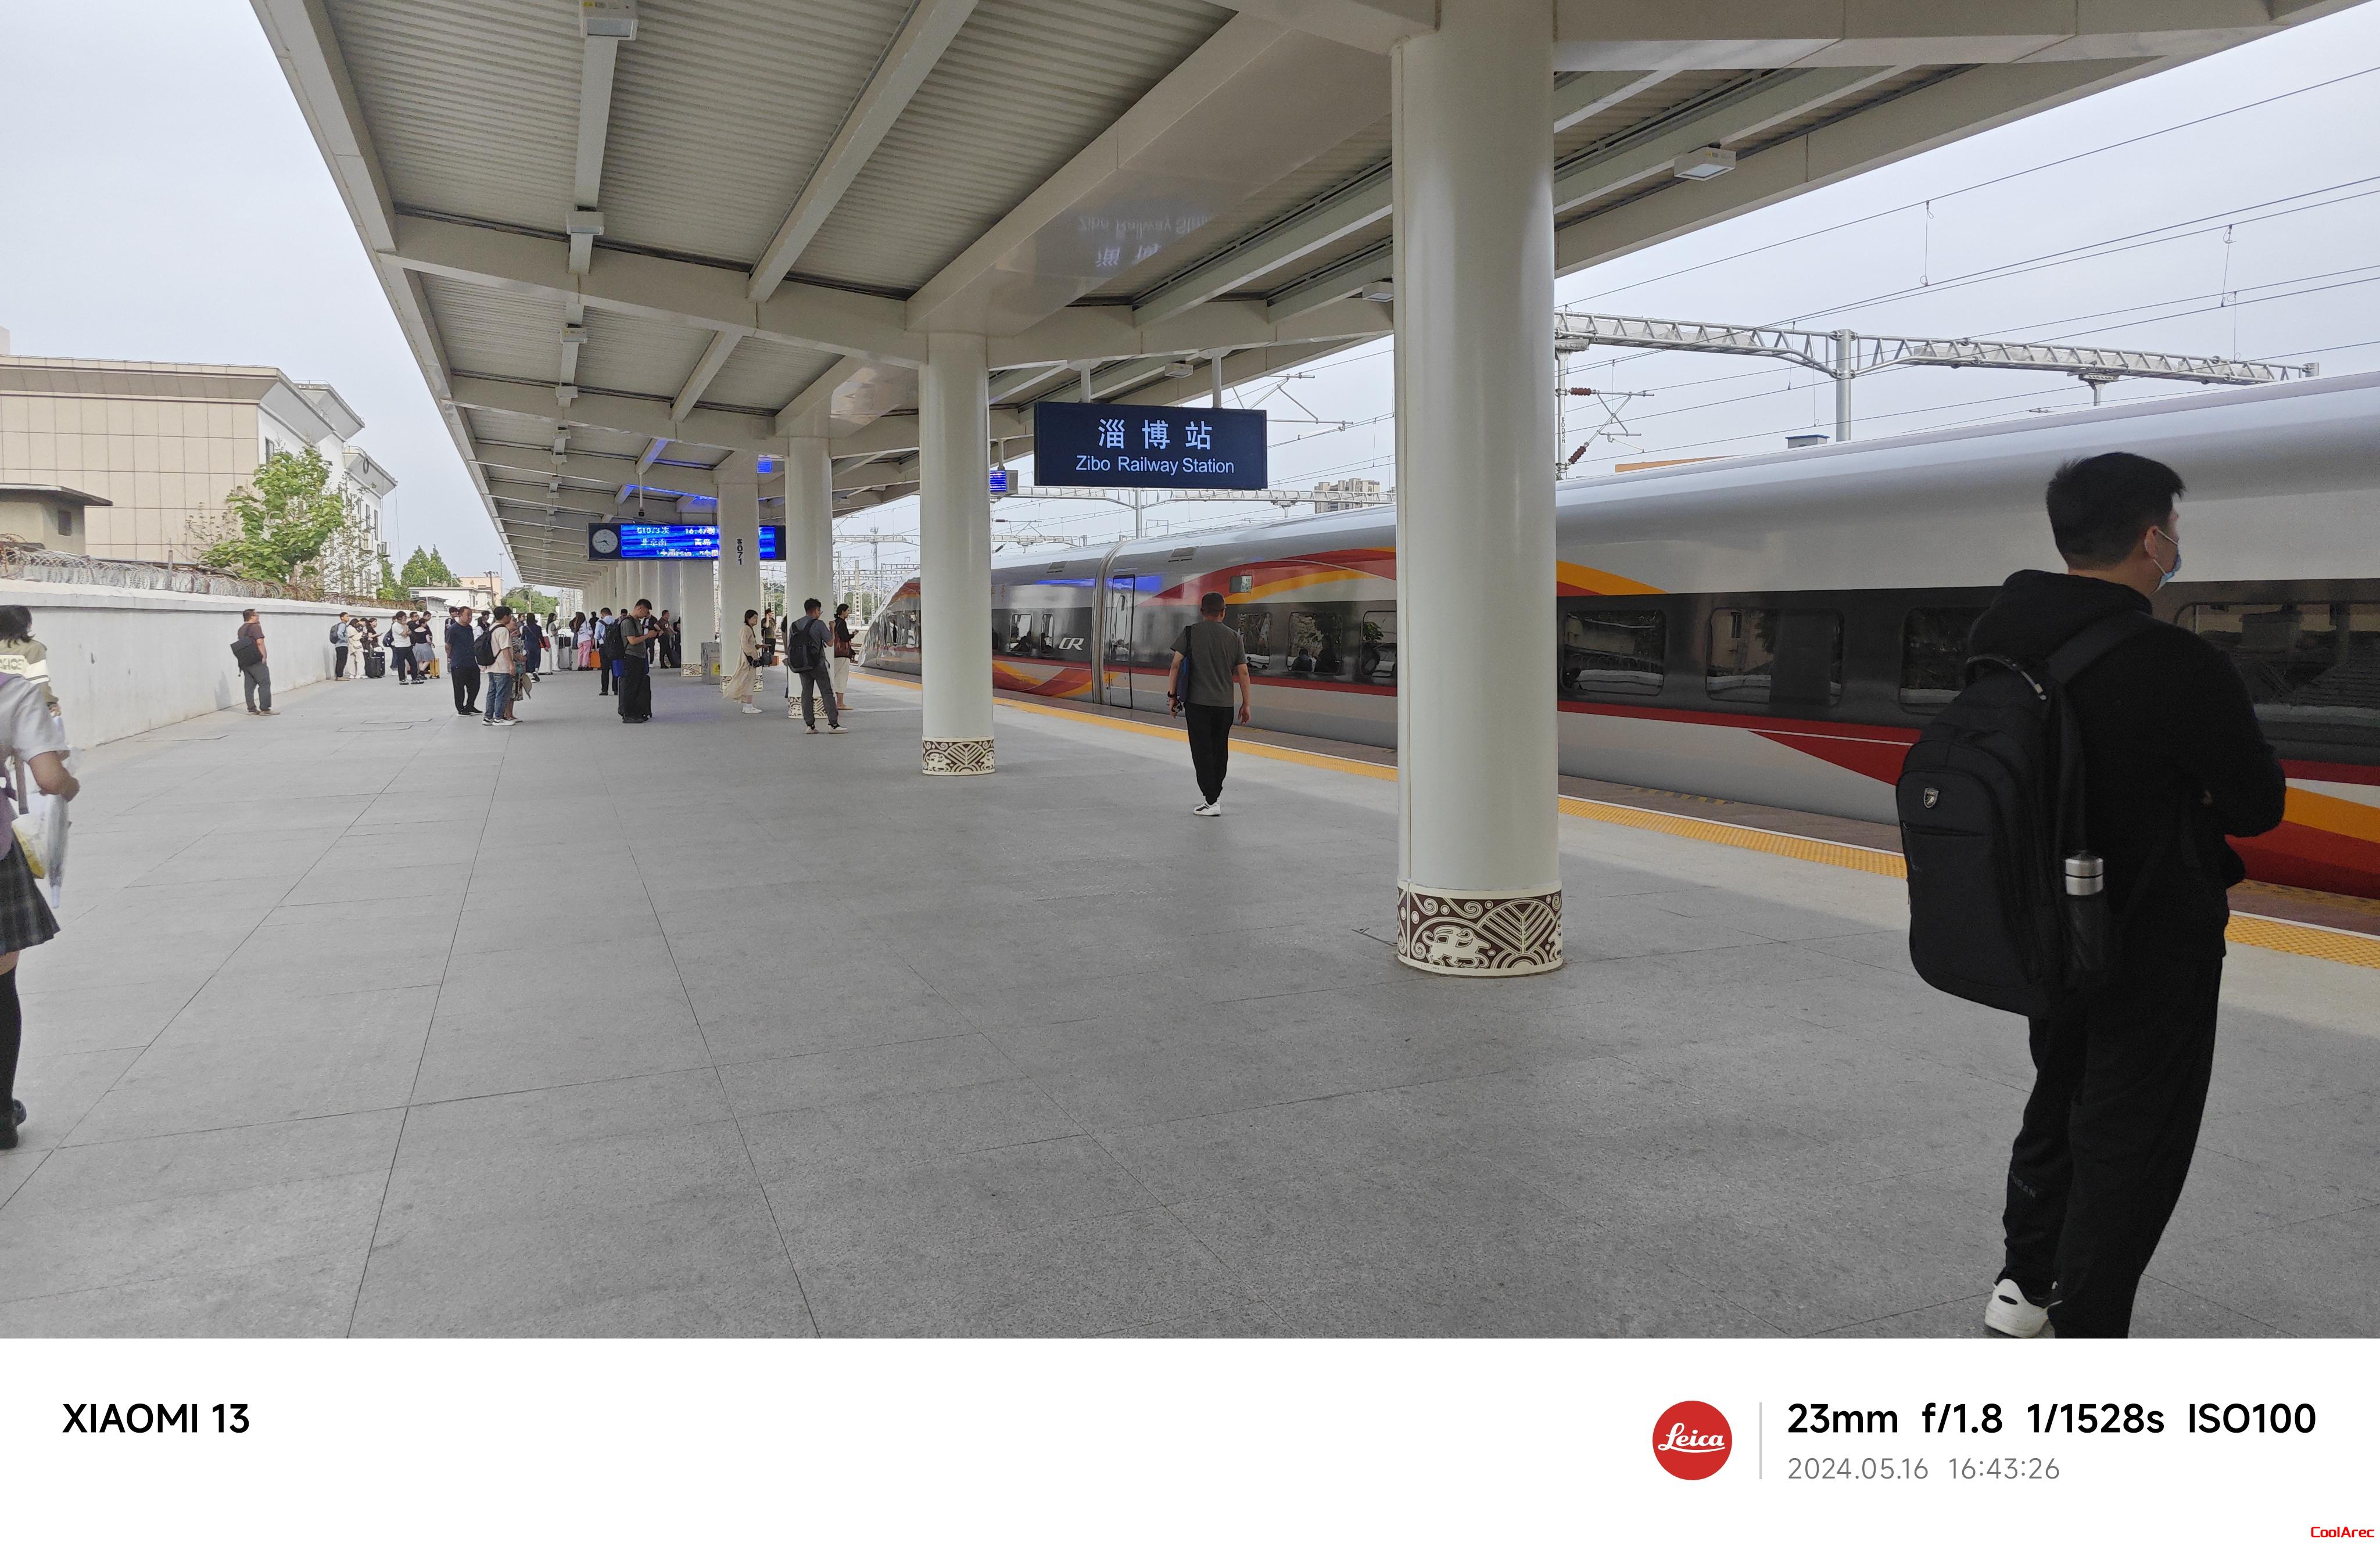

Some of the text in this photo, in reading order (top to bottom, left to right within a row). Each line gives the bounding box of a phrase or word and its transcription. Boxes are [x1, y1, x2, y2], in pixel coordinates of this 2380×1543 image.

[1098, 419, 1212, 450] 淄博站
[1076, 455, 1234, 476] Zibo Railway Station
[1059, 637, 1084, 651] CR
